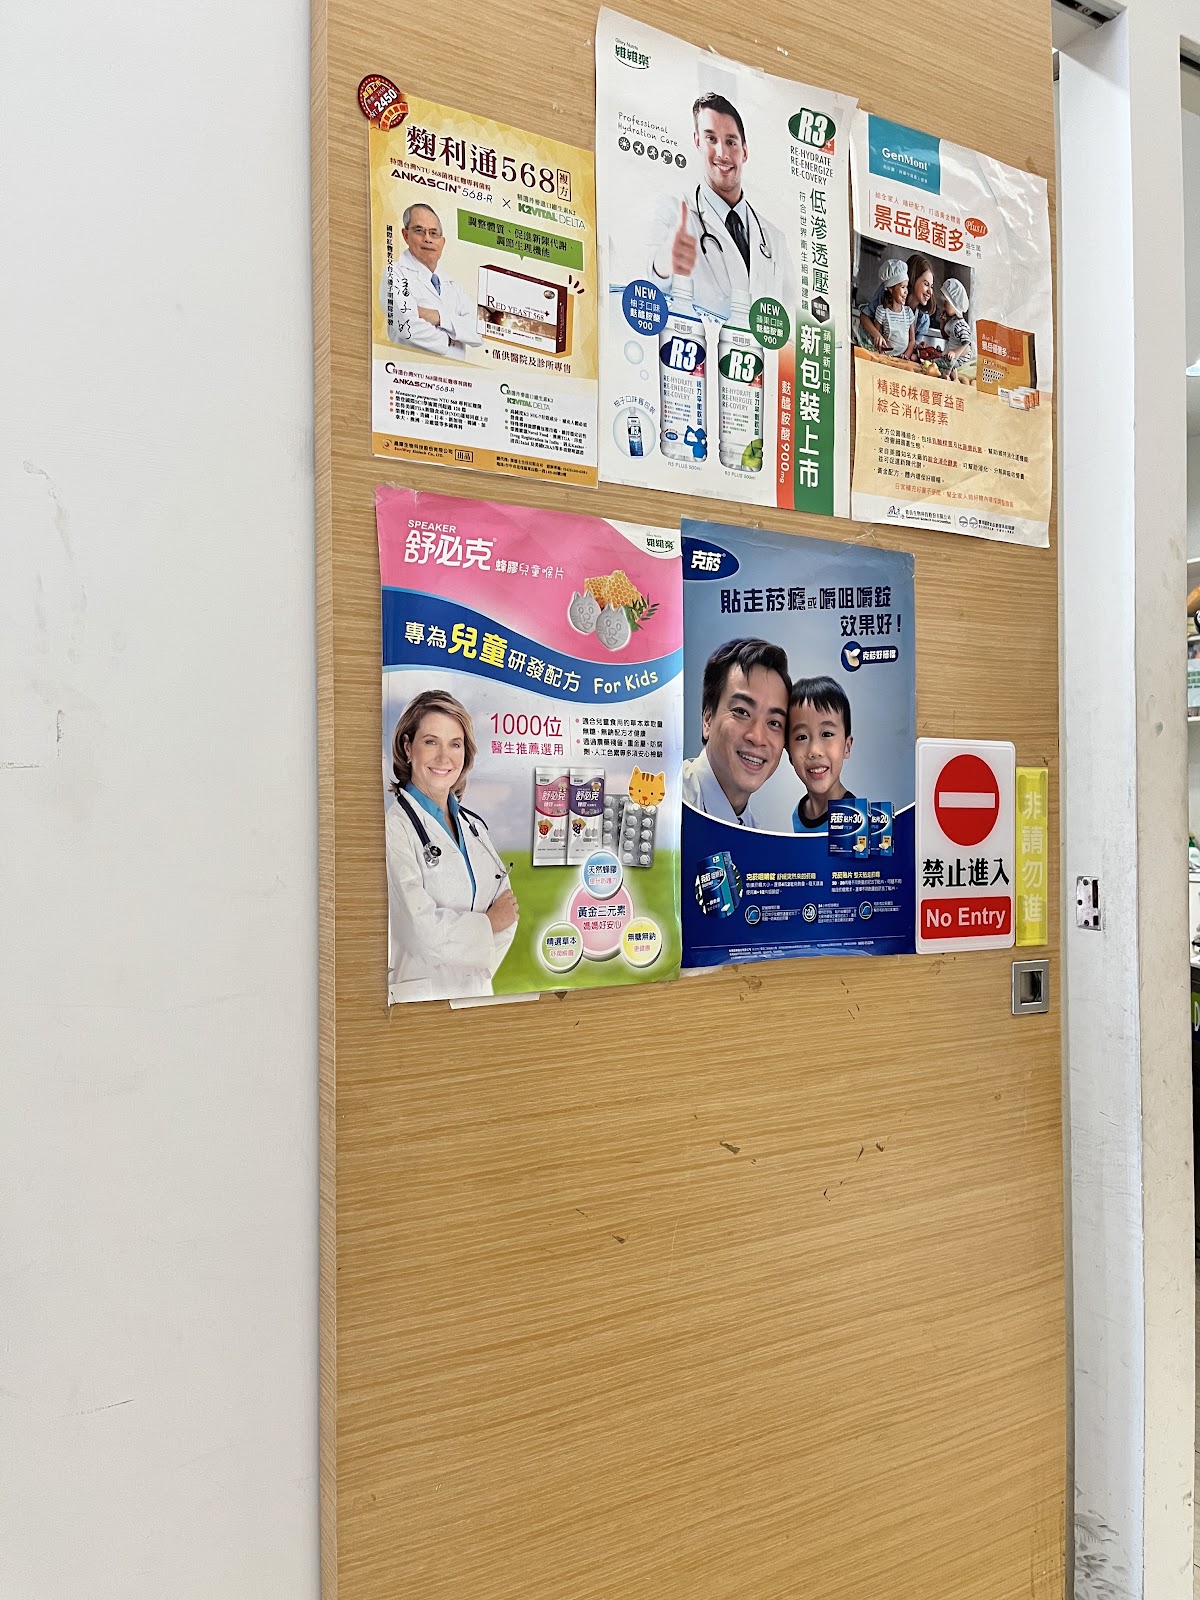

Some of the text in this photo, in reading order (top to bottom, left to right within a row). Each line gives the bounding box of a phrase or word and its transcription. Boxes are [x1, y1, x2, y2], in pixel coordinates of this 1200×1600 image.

[374, 89, 398, 112] 2450
[618, 111, 668, 134] Professional
[797, 109, 829, 146] R3
[618, 122, 678, 147] Hydration Care
[789, 145, 832, 168] RE-HYDRATE
[789, 156, 834, 179] RE-ENERGIZE
[881, 147, 929, 171] GenMont
[390, 169, 493, 204] ANKASCIN 568-R
[559, 171, 571, 199] 複方
[790, 166, 827, 186] RE-COVERY
[875, 191, 899, 205] 給全家人
[558, 214, 586, 230] DELTA
[874, 204, 964, 252] 景岳優菌多
[496, 235, 551, 259] 調節生理機能
[809, 188, 829, 295] 低滲透壓
[634, 284, 657, 301] NEW
[487, 295, 545, 321] RED YEAST 568
[630, 298, 661, 313] 柚子口味
[759, 302, 780, 316] NEW
[638, 320, 653, 331] 900
[756, 314, 784, 328] 蘋果口味
[763, 335, 777, 346] 900
[492, 349, 572, 374] 僅供醫院及診所專售
[670, 338, 697, 370] R3
[822, 329, 832, 394] 蘋果新口味
[729, 351, 756, 382] R3
[392, 377, 433, 390] ANKASCIN
[663, 374, 693, 388] RE-HYDRATE
[663, 382, 695, 396] RE-ENERGIZE
[722, 386, 752, 398] RE-HYDRATE
[507, 397, 551, 411] K2VITAL DELTA
[663, 389, 691, 401] RE-COVERY
[722, 393, 753, 406] RE-ENERGIZE
[722, 401, 749, 411] RE-COVERY
[799, 324, 821, 488] 新包裝上市
[877, 378, 965, 412] 精選6株優質益菌
[877, 398, 949, 426] 綜合消化酵素
[407, 519, 457, 534] SPEAKER
[403, 529, 494, 571] 舒必克
[690, 549, 722, 572] 克菸
[495, 559, 566, 581] 蜂膠兒童喉片
[720, 586, 892, 614] 貼走菸癮或嚼咀嚼錠
[840, 613, 902, 637] 效果好!
[405, 621, 582, 694] 專為兒童研發配方
[594, 669, 659, 694] For Kids
[490, 712, 563, 738] 1000位
[491, 740, 564, 757] 醫生推薦選用
[541, 790, 567, 801] 舒必克
[575, 790, 601, 801] 舒必克
[1021, 791, 1043, 924] 非請勿進
[588, 865, 618, 875] 天然蜂膠
[922, 857, 1010, 888] 禁止進入
[577, 905, 626, 919] 黃金三元素
[926, 908, 952, 928] No
[958, 906, 1006, 930] Entry
[583, 920, 622, 930] 媽媽好安心
[546, 936, 577, 947] 精選草本
